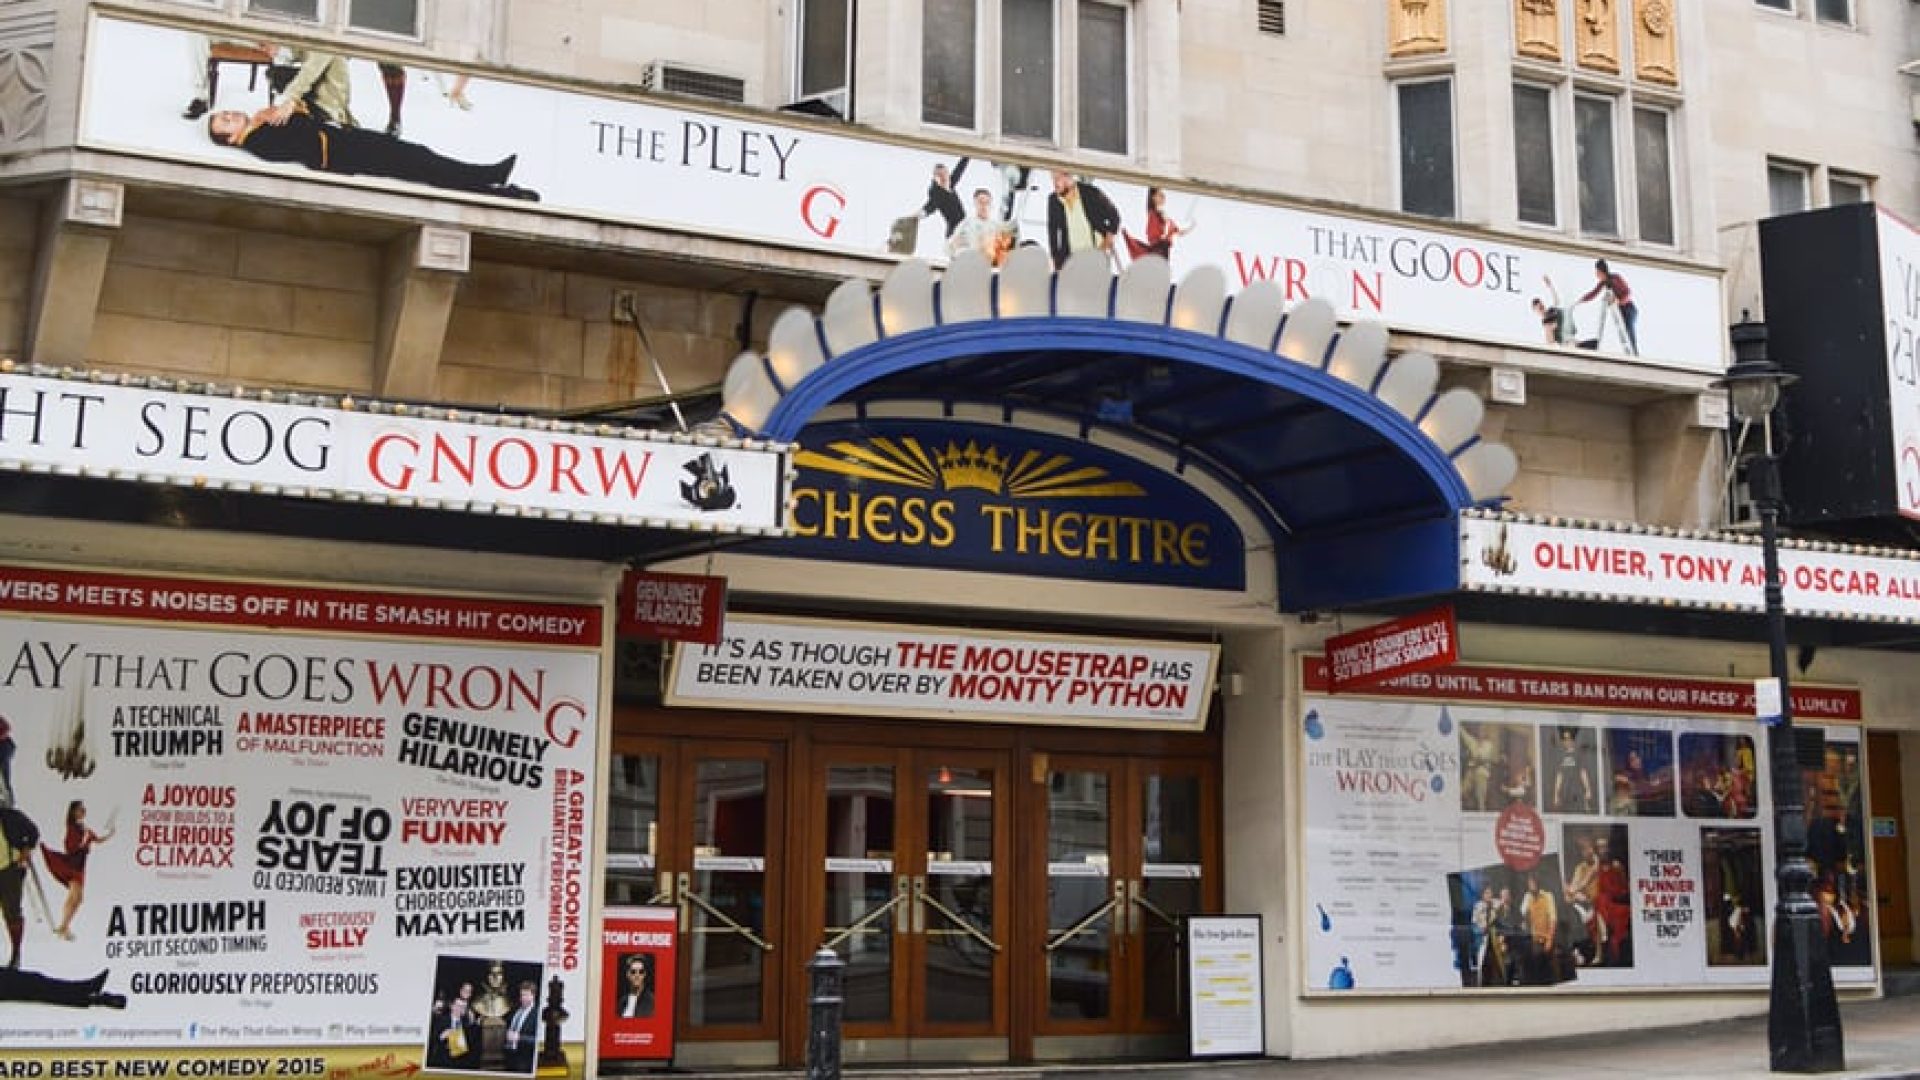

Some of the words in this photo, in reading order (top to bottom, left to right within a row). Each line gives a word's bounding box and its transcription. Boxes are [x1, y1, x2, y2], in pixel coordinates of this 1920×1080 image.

[588, 120, 665, 162] THE
[680, 120, 799, 180] PLEY
[799, 185, 846, 237] G
[1308, 226, 1383, 263] THAT
[1390, 237, 1521, 292] GOOSE
[0, 387, 104, 448] HT
[135, 400, 331, 471] SEOG
[368, 432, 652, 498] GNORW
[789, 488, 955, 546] CHESS
[981, 504, 1210, 565] THEATRE
[1534, 540, 1653, 580] OLIVIER,
[1660, 553, 1732, 583] TONY
[1794, 565, 1879, 595] OSCAR
[66, 584, 144, 606] MEETS
[151, 591, 237, 613] NOISES
[243, 597, 289, 615] OFF
[296, 600, 318, 617] IN
[325, 602, 368, 620] THE
[375, 604, 449, 625] SMASH
[457, 610, 491, 629] HIT
[497, 613, 587, 635] COMEDY
[4, 641, 78, 688] AY
[85, 652, 199, 690] THAT
[209, 651, 354, 704] GOES
[750, 638, 782, 659] AS
[788, 641, 891, 666] THOUGH
[896, 641, 957, 669] THE
[962, 645, 1149, 680] MOUSETRAP
[1150, 660, 1192, 680] HAS
[697, 663, 761, 685] BEEN
[768, 665, 843, 689] TAKEN
[848, 670, 911, 693] OVER
[915, 674, 945, 694] BY
[949, 674, 1063, 704] MONTY
[1067, 680, 1188, 708] PYTHON
[1436, 675, 1481, 690] UNTIL
[1486, 677, 1515, 693] THE
[1521, 679, 1568, 696] TEARS
[1574, 682, 1603, 697] RAN
[1607, 683, 1651, 700] DOWN
[1656, 686, 1687, 702] OUR
[112, 706, 125, 727] A
[128, 705, 223, 727] TECHNICAL
[1798, 696, 1847, 712] LUMLEY
[237, 711, 250, 733] A
[256, 712, 385, 739] MASTERPIECE
[402, 711, 550, 761] GENUINELY
[111, 729, 222, 757] TRIUMPH
[236, 736, 261, 751] OF
[264, 739, 383, 757] MALFUNCTION
[398, 738, 543, 788] HILARIOUS
[571, 769, 584, 784] A
[143, 783, 155, 805] A
[160, 784, 236, 808] JOYOUS
[1335, 769, 1426, 801] WRONG
[258, 799, 336, 837] JOY
[340, 807, 391, 842] OF
[402, 820, 507, 844] FUNNY
[139, 825, 234, 845] DELIRIOUS
[135, 846, 234, 868] CLIMAX
[255, 835, 388, 876] TEARS
[253, 869, 271, 890] TO
[275, 872, 343, 893] REDUCED
[346, 878, 377, 897] WAS
[395, 862, 525, 890] EXQUISITELY
[395, 889, 524, 911] CHOREOGRAPHED
[107, 904, 126, 936] A
[133, 900, 265, 936] TRIUMPH
[299, 911, 376, 927] INFECTIOUSLY
[396, 909, 524, 937] MAYHEM
[106, 939, 125, 958] OF
[127, 938, 162, 957] SPLIT
[165, 937, 217, 955] SECOND
[220, 934, 267, 952] TIMING
[306, 927, 368, 948] SILLY
[130, 973, 246, 994] GLORIOUSLY
[250, 972, 378, 994] PREPOSTEROUS
[0, 1059, 42, 1077] ARD
[51, 1059, 108, 1077] BEST
[115, 1059, 169, 1076] NEW
[177, 1058, 269, 1076] COMEDY
[276, 1057, 325, 1075] 2015
